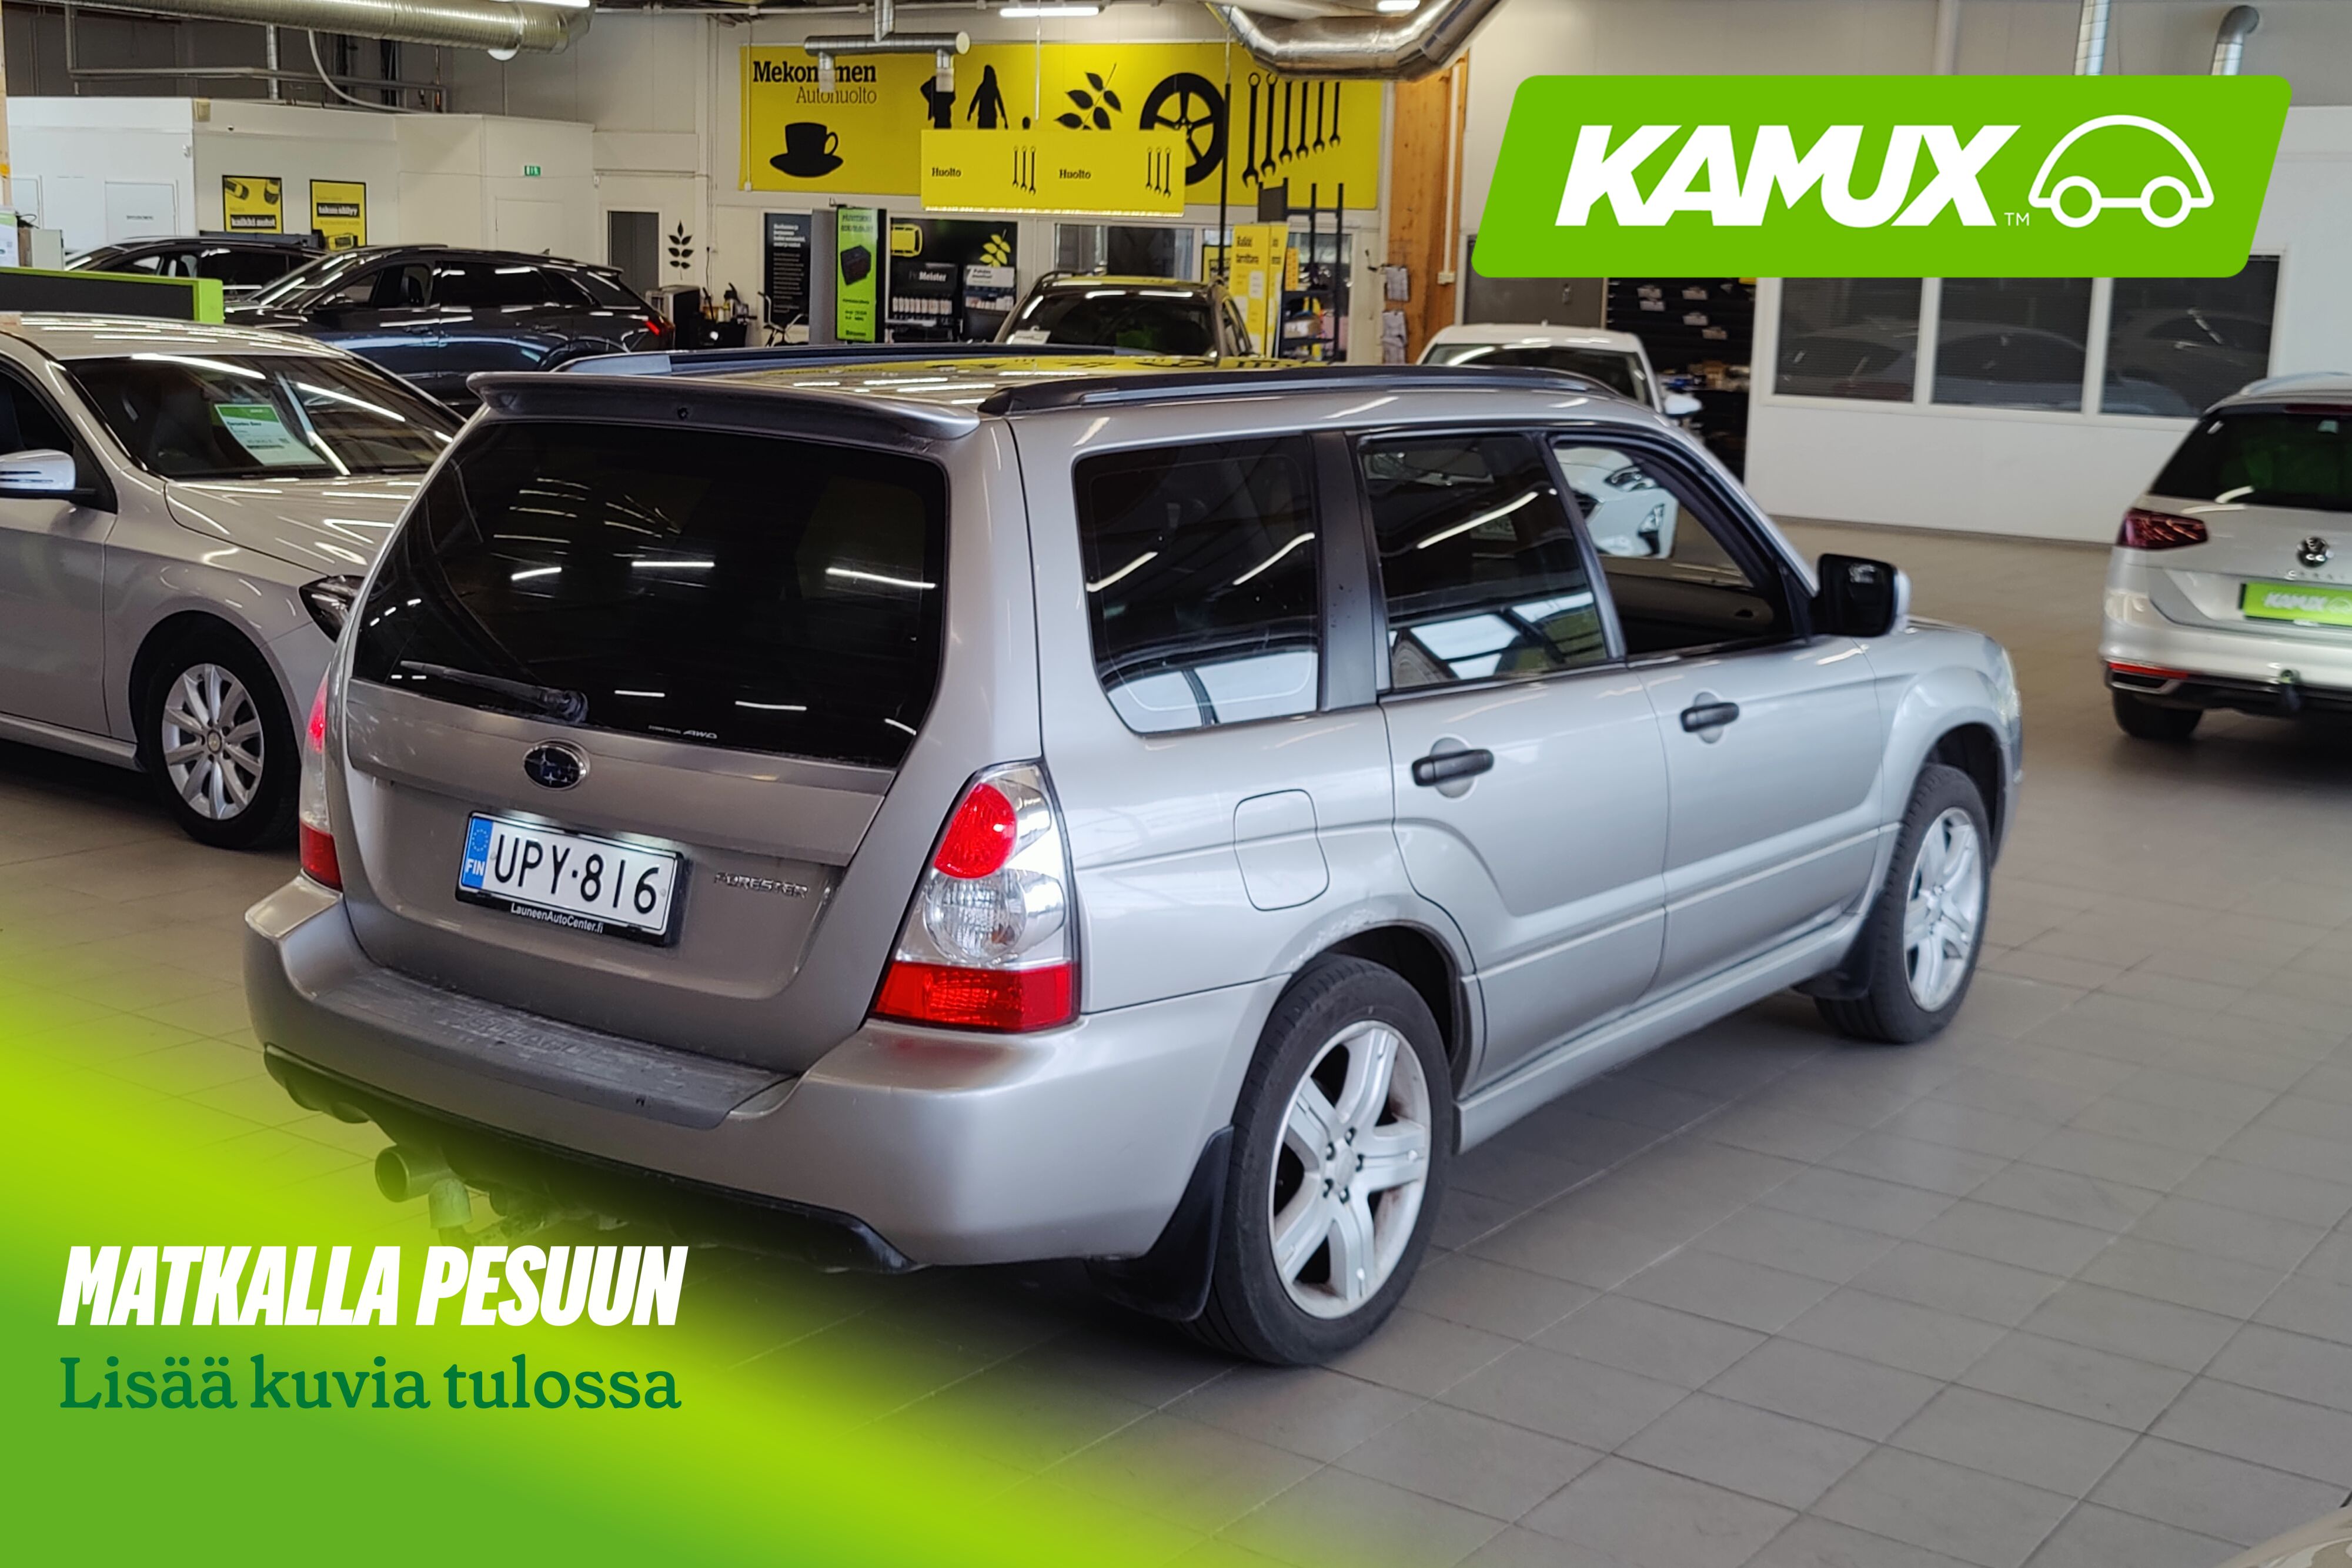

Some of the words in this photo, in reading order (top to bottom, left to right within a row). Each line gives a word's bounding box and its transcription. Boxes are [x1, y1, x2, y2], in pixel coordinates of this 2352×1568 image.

[753, 61, 876, 82] Mekonmen
[931, 167, 961, 178] Huolto
[1059, 169, 1091, 179] Huolto
[683, 730, 717, 739] AWD
[465, 858, 486, 877] FIN
[510, 902, 604, 934] LauneenAutoCenter.fi
